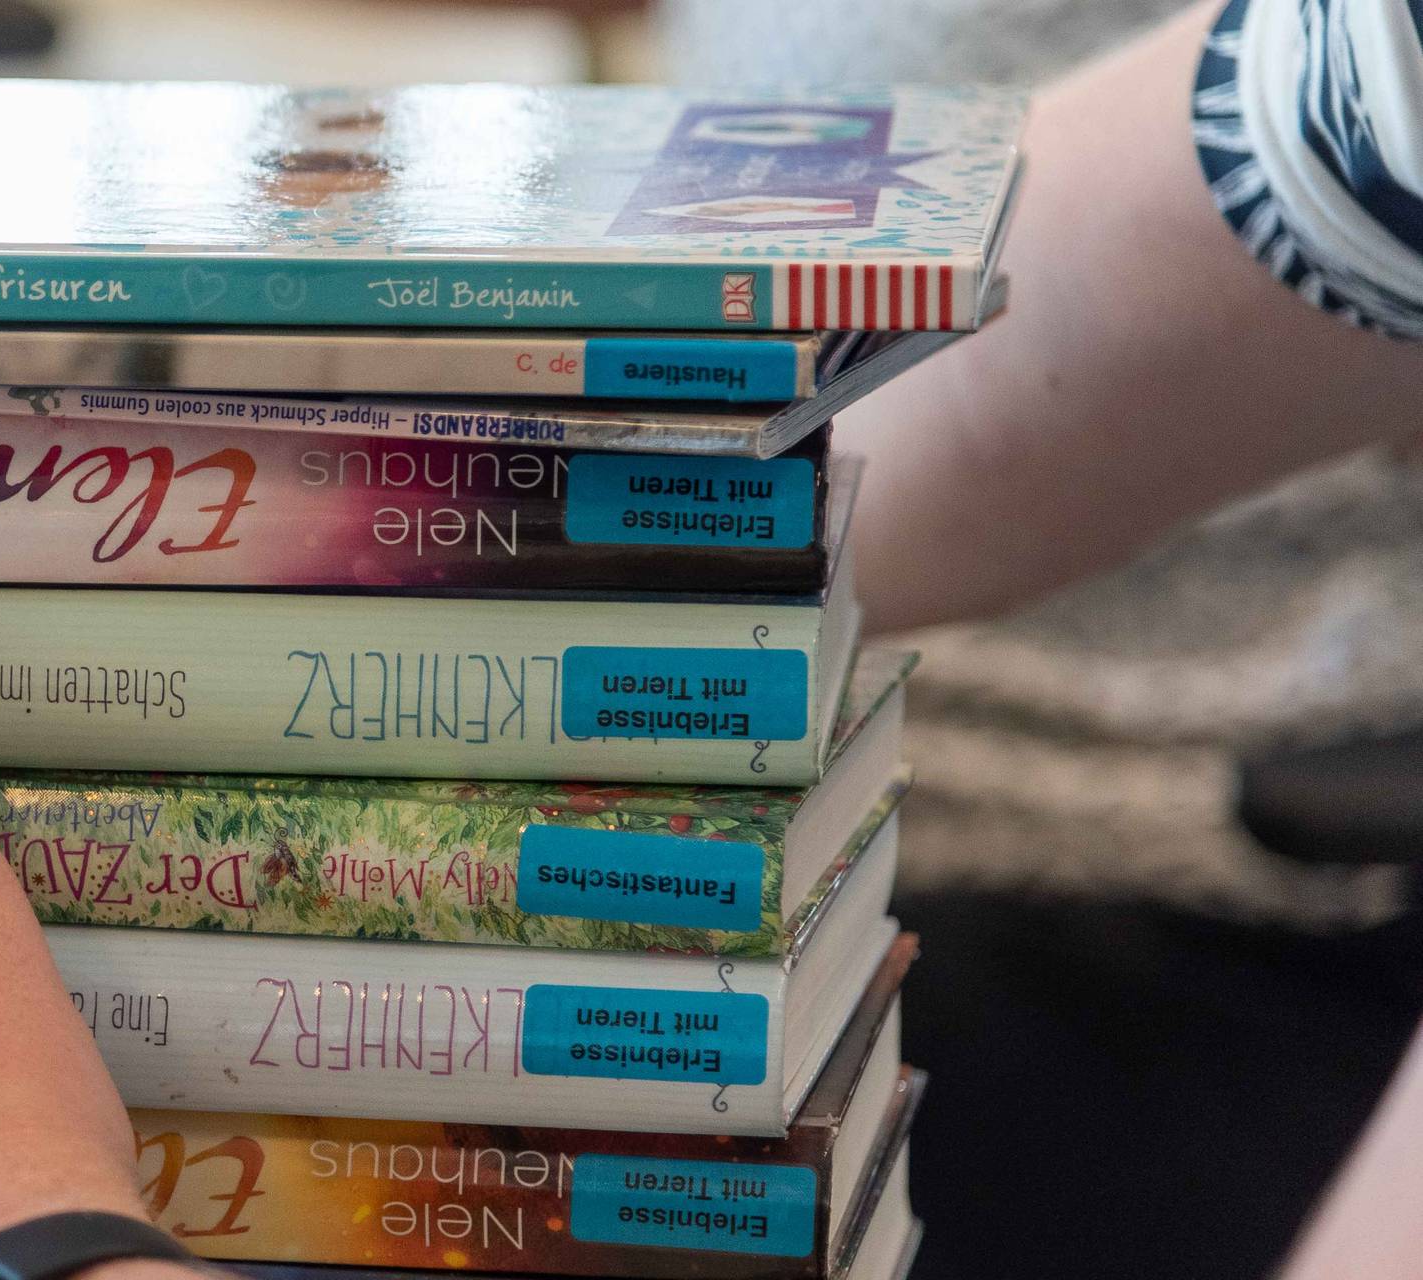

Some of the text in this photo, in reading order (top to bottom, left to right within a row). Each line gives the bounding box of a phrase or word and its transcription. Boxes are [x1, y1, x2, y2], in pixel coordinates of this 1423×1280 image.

[367, 277, 581, 320] Joël Benjamin
[724, 277, 751, 317] DK
[516, 351, 578, 375] C. de
[623, 359, 747, 390] Haustiere
[80, 394, 151, 417] Gummis
[152, 398, 212, 420] coolen
[216, 402, 247, 420] aus
[250, 403, 327, 428] Schmuck
[330, 404, 391, 430] Hipper
[412, 411, 566, 443] RUBBERBANDS!
[628, 474, 774, 503] mit Tieren
[373, 506, 518, 556] Nele
[621, 508, 775, 540] Erlebnisse
[0, 664, 32, 716] im
[45, 664, 187, 719] Schatten
[283, 650, 657, 746] LKENHERZ
[602, 673, 748, 702] mit Tieren
[595, 708, 751, 739] Erlebnisse
[145, 850, 258, 910] Der
[321, 852, 430, 904] Möhle
[536, 862, 737, 906] Fantastisches
[111, 992, 169, 1047] Eine
[249, 977, 526, 1078] LKENHERZ
[575, 1007, 720, 1037] mit Tieren
[569, 1040, 722, 1074] Erlebnisse
[624, 1170, 767, 1204] mit Tieren
[380, 1200, 524, 1251] Nele
[616, 1205, 770, 1239] Erlebnisse
